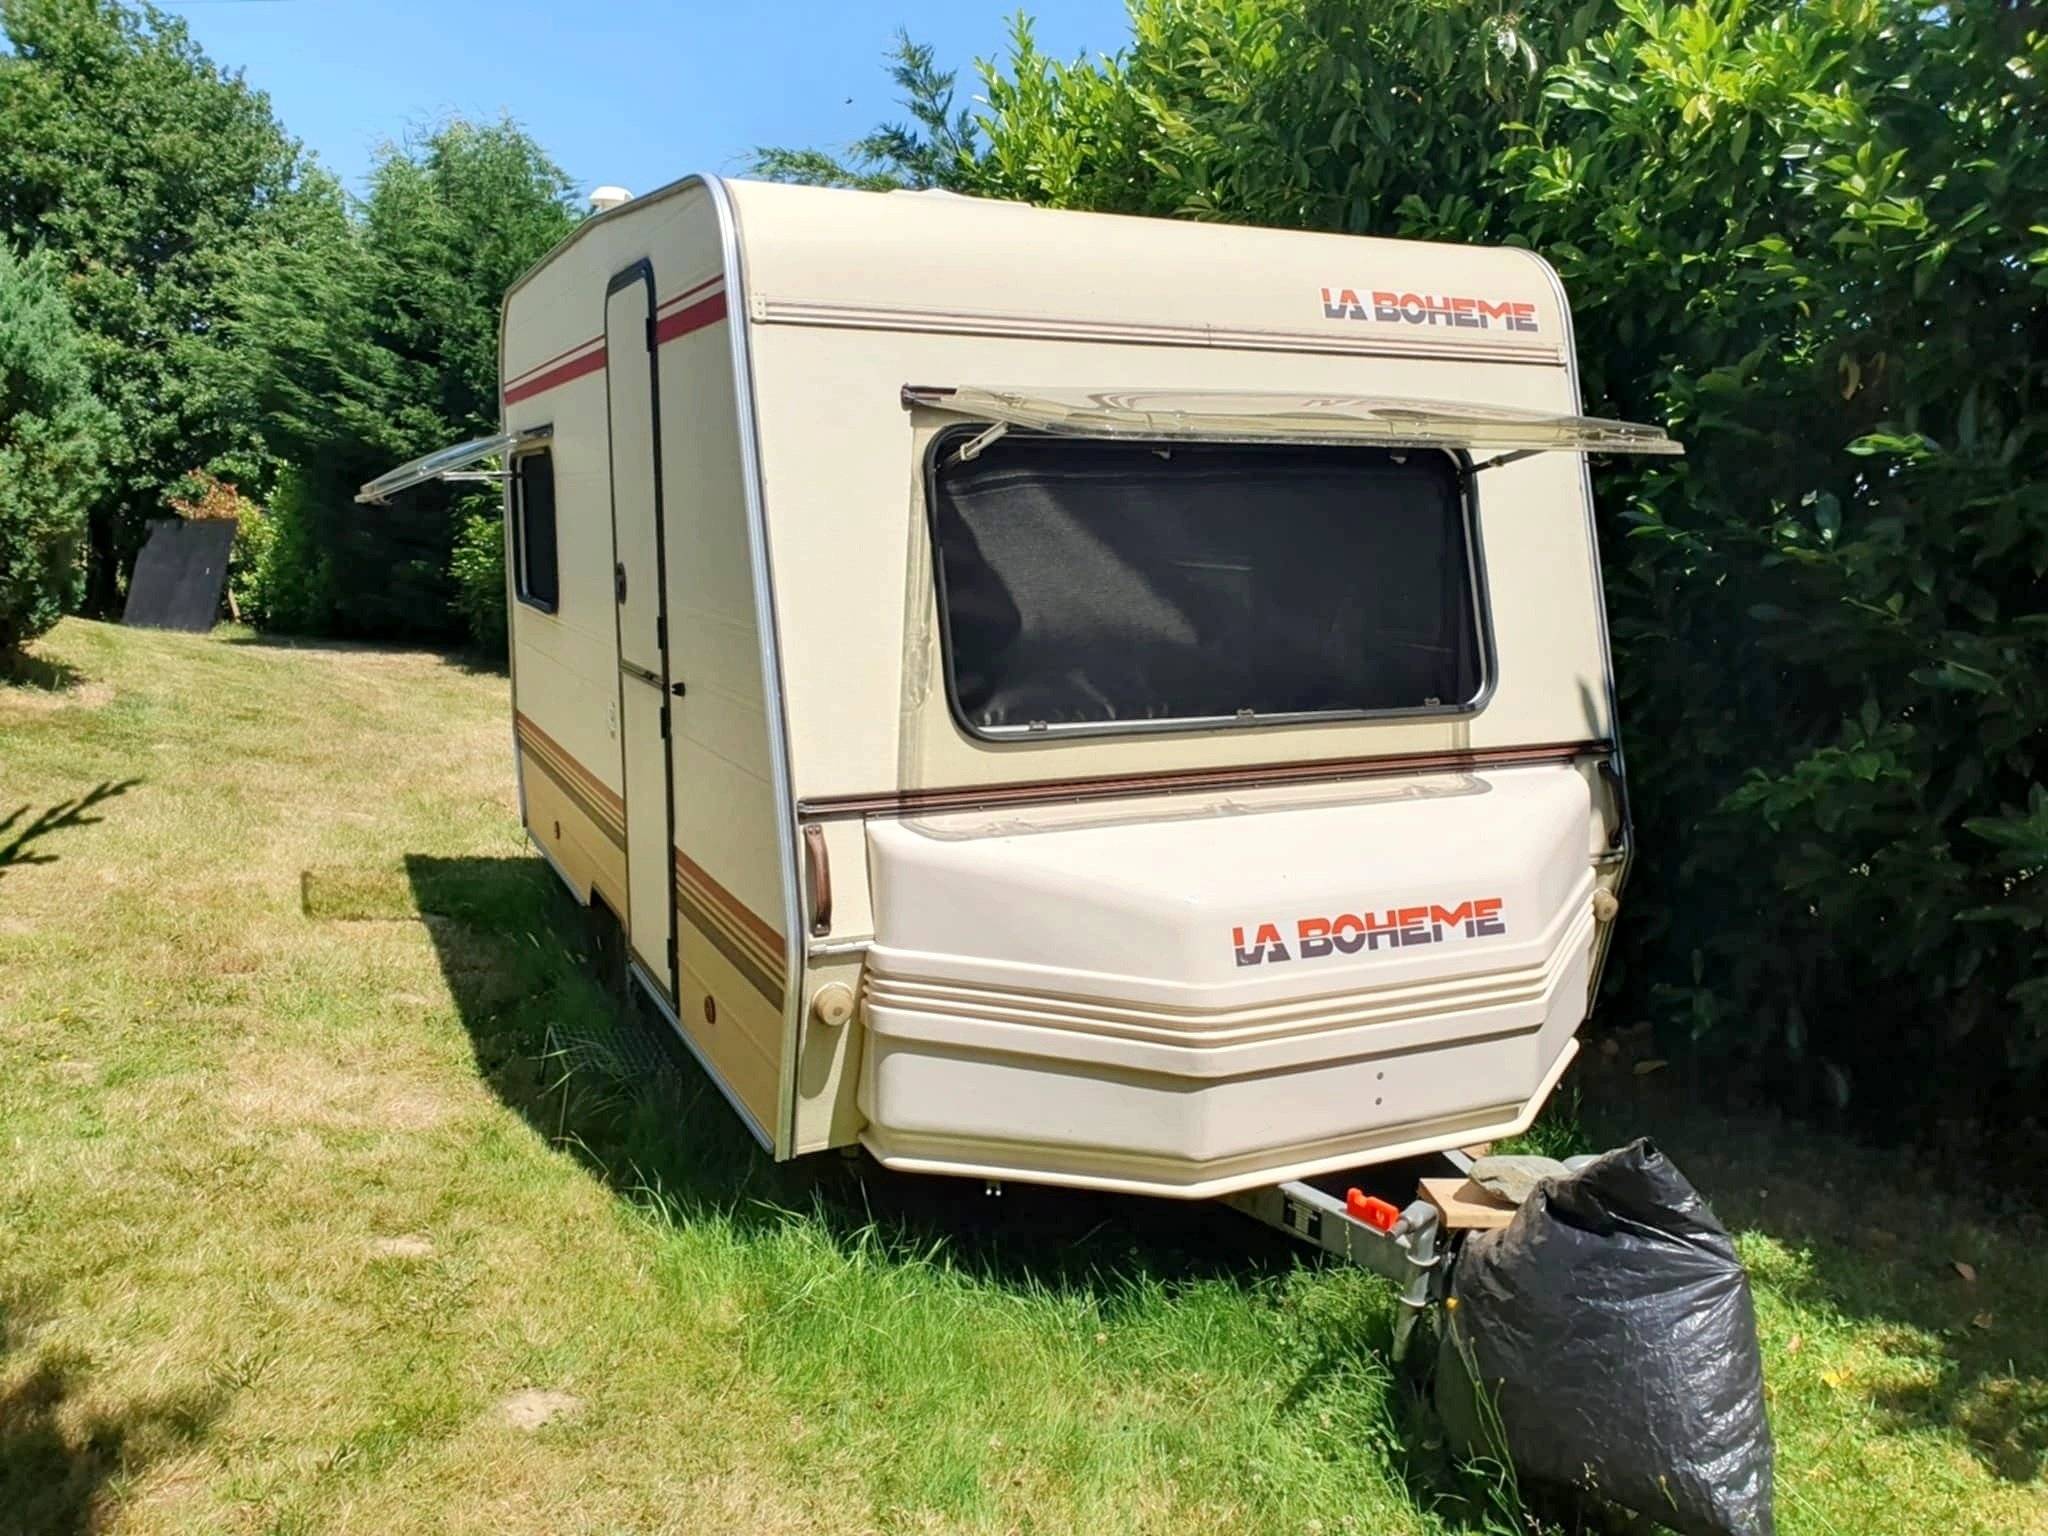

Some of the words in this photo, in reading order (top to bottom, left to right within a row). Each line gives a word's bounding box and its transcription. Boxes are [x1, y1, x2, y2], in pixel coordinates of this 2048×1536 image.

[1321, 288, 1368, 320] LA
[1372, 291, 1538, 332] BOHEME
[1232, 923, 1291, 967] LA
[1297, 898, 1505, 958] BOHEME
